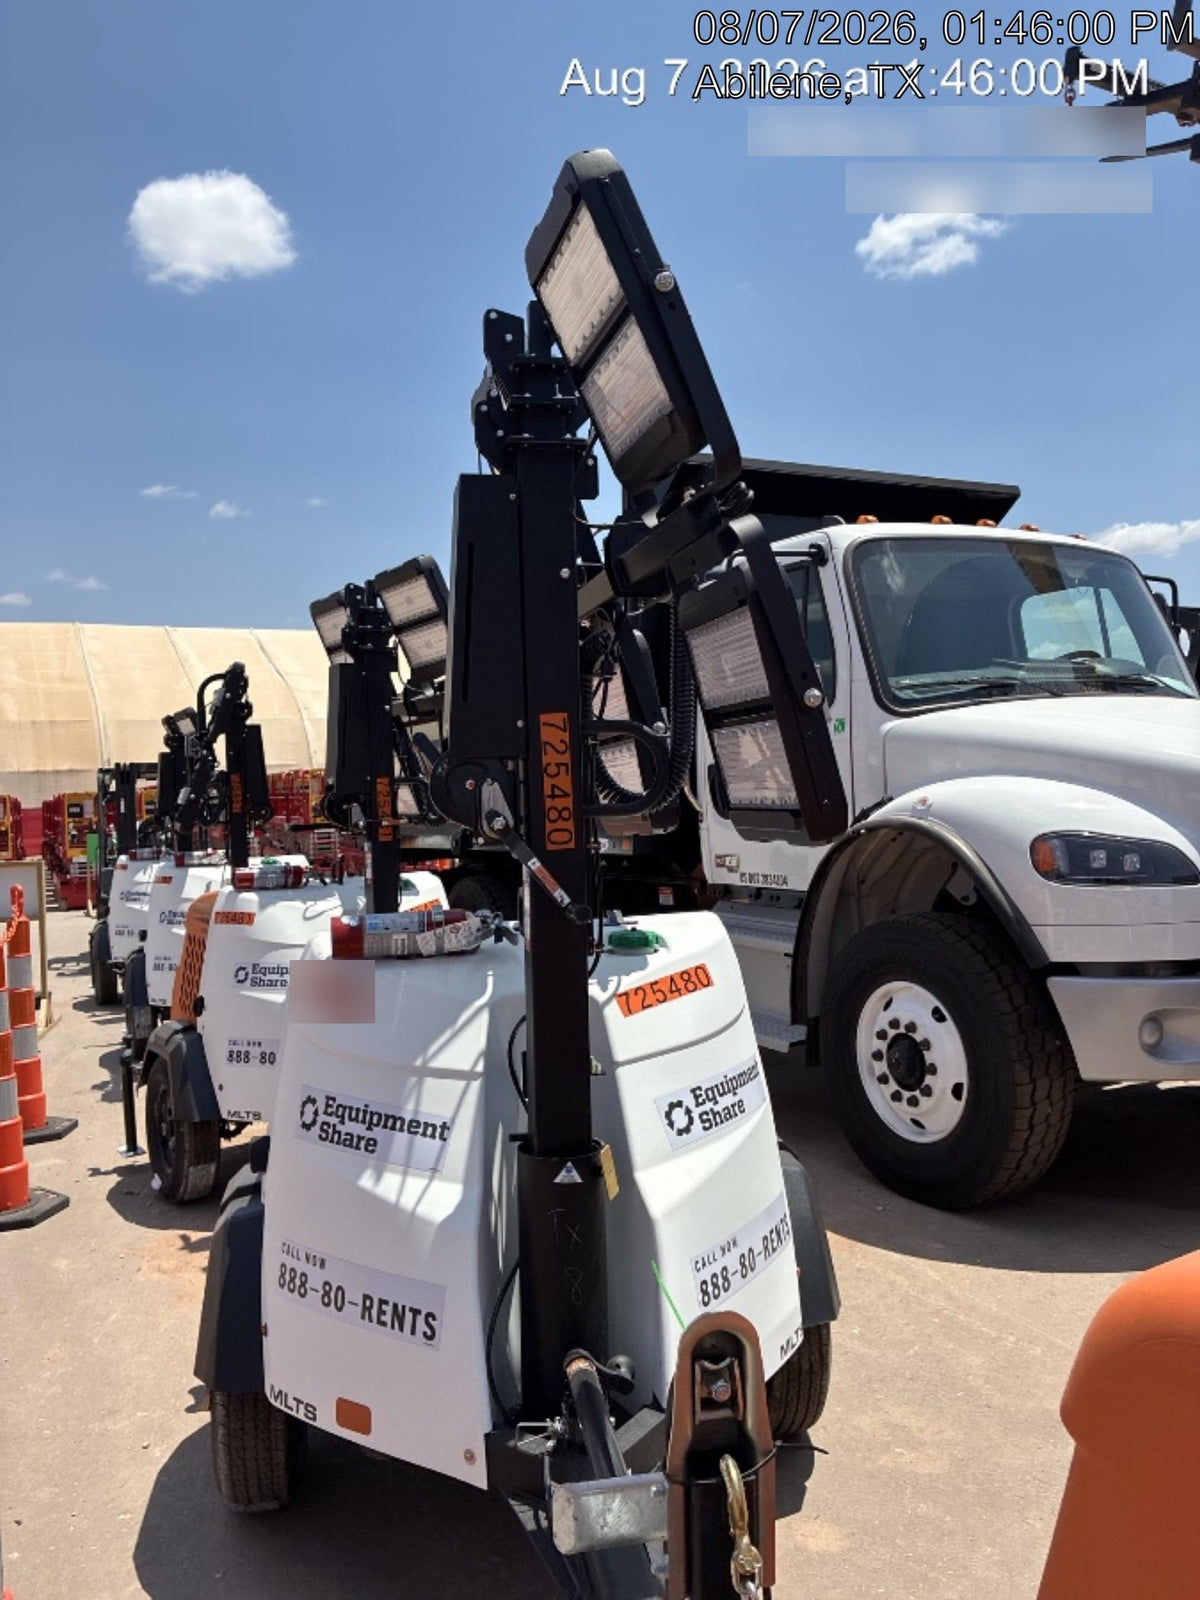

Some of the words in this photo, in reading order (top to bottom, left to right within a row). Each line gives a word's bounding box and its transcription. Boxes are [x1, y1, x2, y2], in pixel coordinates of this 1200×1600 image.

[542, 716, 573, 846] 725480
[249, 975, 289, 988] Share
[617, 966, 711, 1015] 725480
[322, 1095, 451, 1142] Equipment
[698, 1098, 746, 1132] Share
[318, 1121, 378, 1155] Share
[281, 1242, 302, 1262] CALL
[305, 1251, 327, 1270] NOW
[695, 1251, 718, 1273] CALL
[278, 1262, 438, 1342] 888-80-RENTS
[270, 1383, 317, 1422] MLTS
